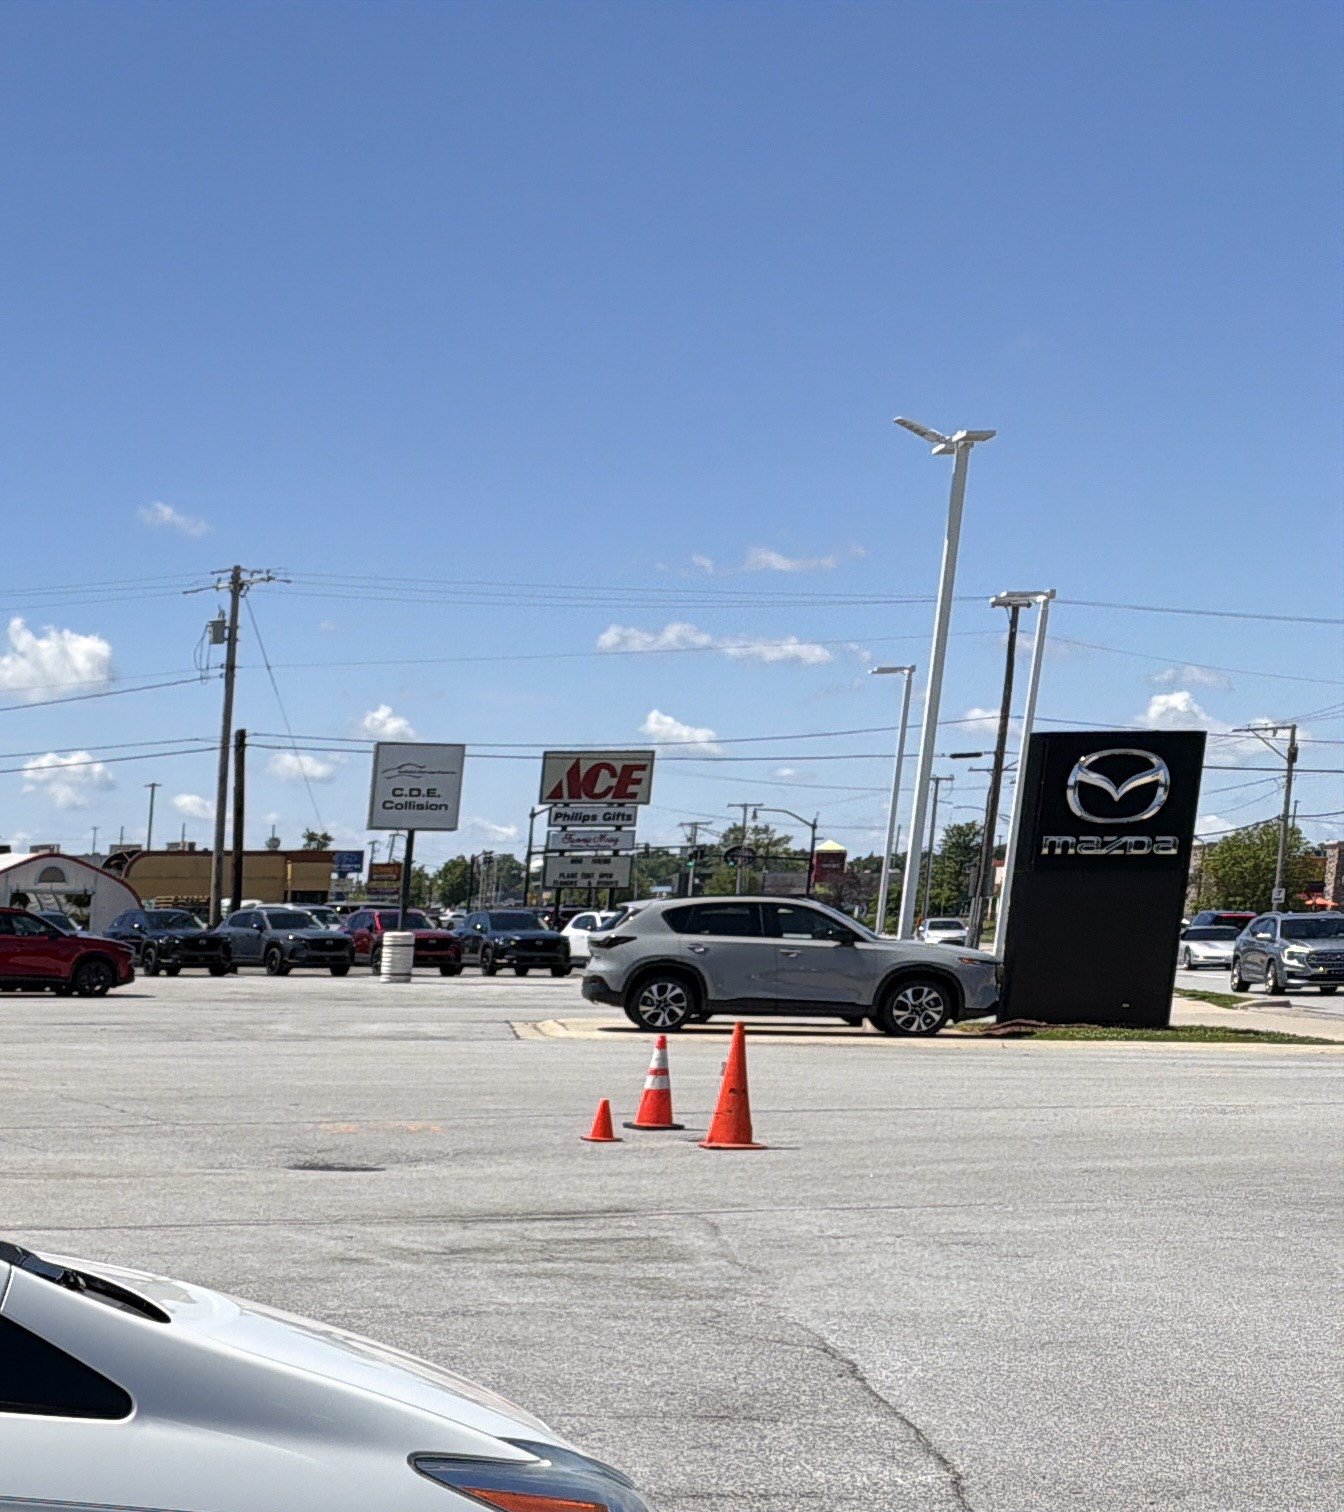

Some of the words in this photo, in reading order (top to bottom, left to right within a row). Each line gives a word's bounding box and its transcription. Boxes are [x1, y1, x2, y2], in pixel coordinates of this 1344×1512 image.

[545, 757, 648, 800] ACE
[392, 787, 441, 798] C.D.E.
[382, 800, 448, 811] Collision
[554, 812, 598, 823] Philips
[602, 811, 633, 822] Gifts
